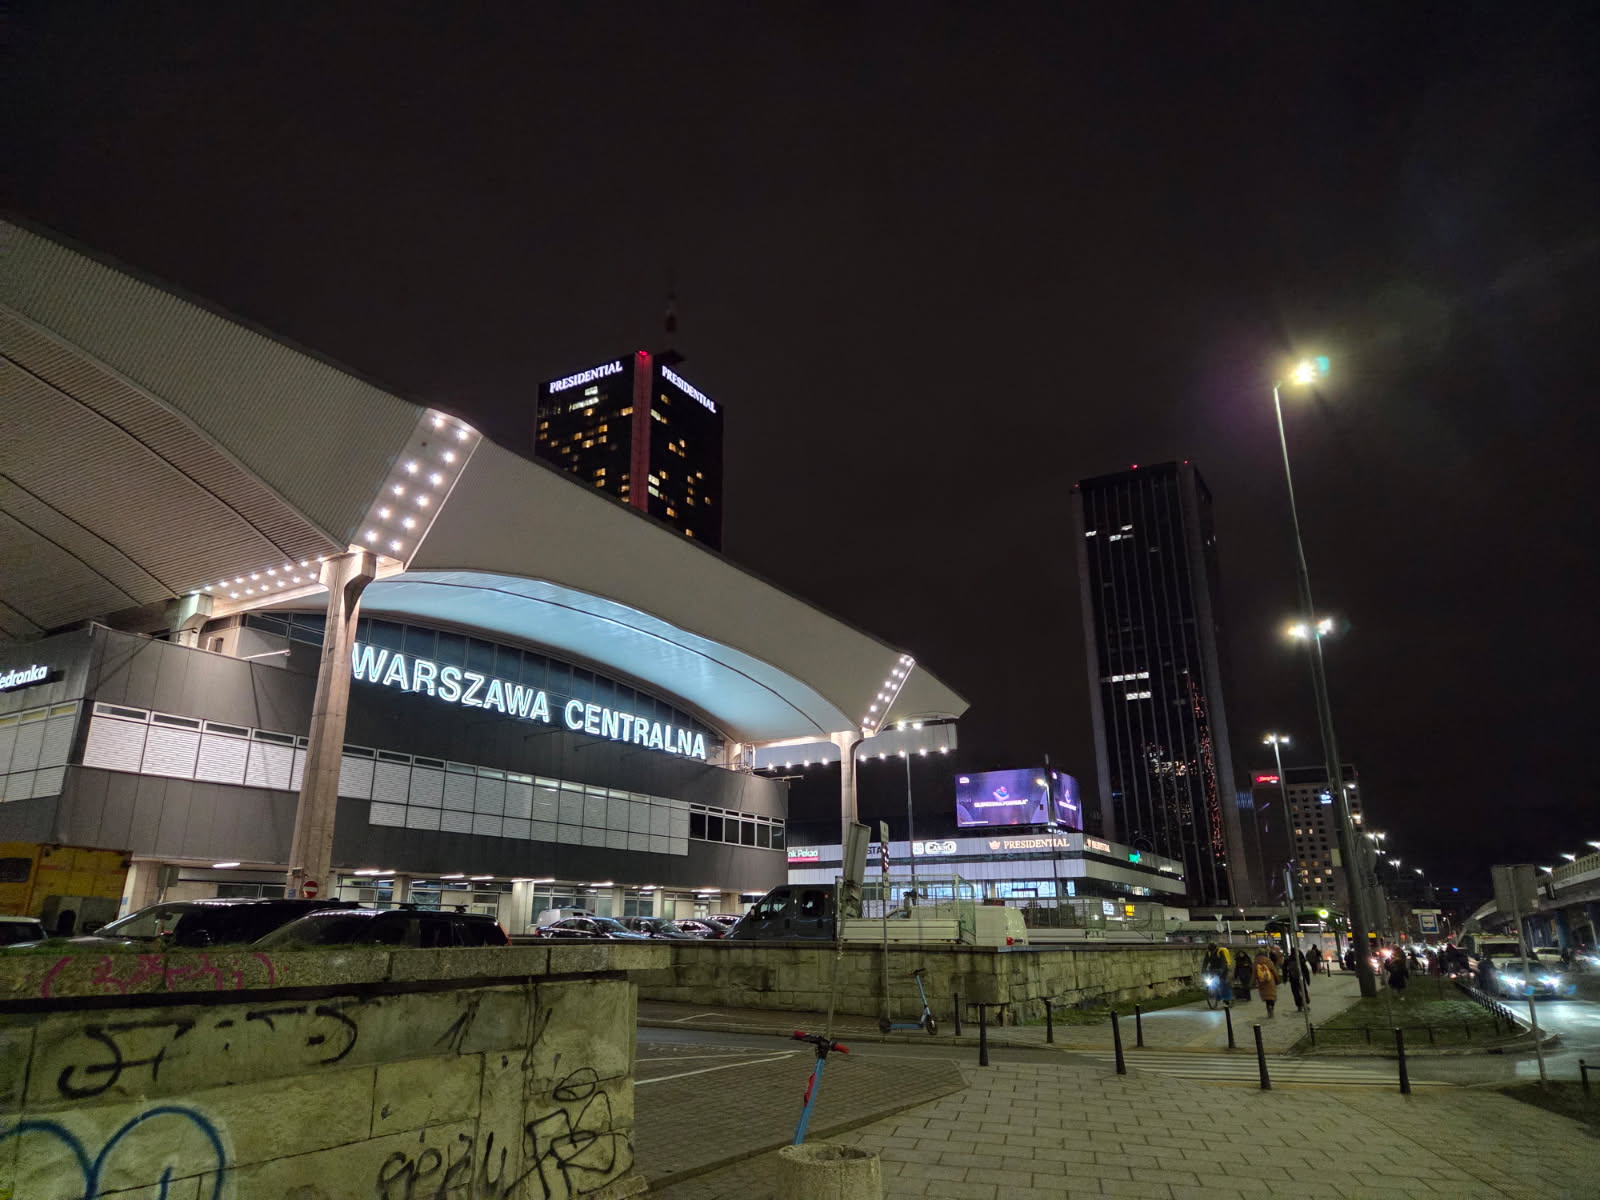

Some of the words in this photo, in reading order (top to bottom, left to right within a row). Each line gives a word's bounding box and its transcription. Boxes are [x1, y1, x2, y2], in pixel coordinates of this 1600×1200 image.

[549, 361, 623, 394] PRESIDENTIAL
[661, 365, 717, 414] PRESIDENTIAL
[352, 642, 551, 724] WARSZAWA
[564, 699, 707, 760] CENTRALNA
[797, 848, 819, 857] Pekao
[867, 846, 882, 855] STA
[1003, 838, 1071, 849] PRESIDENTIAL
